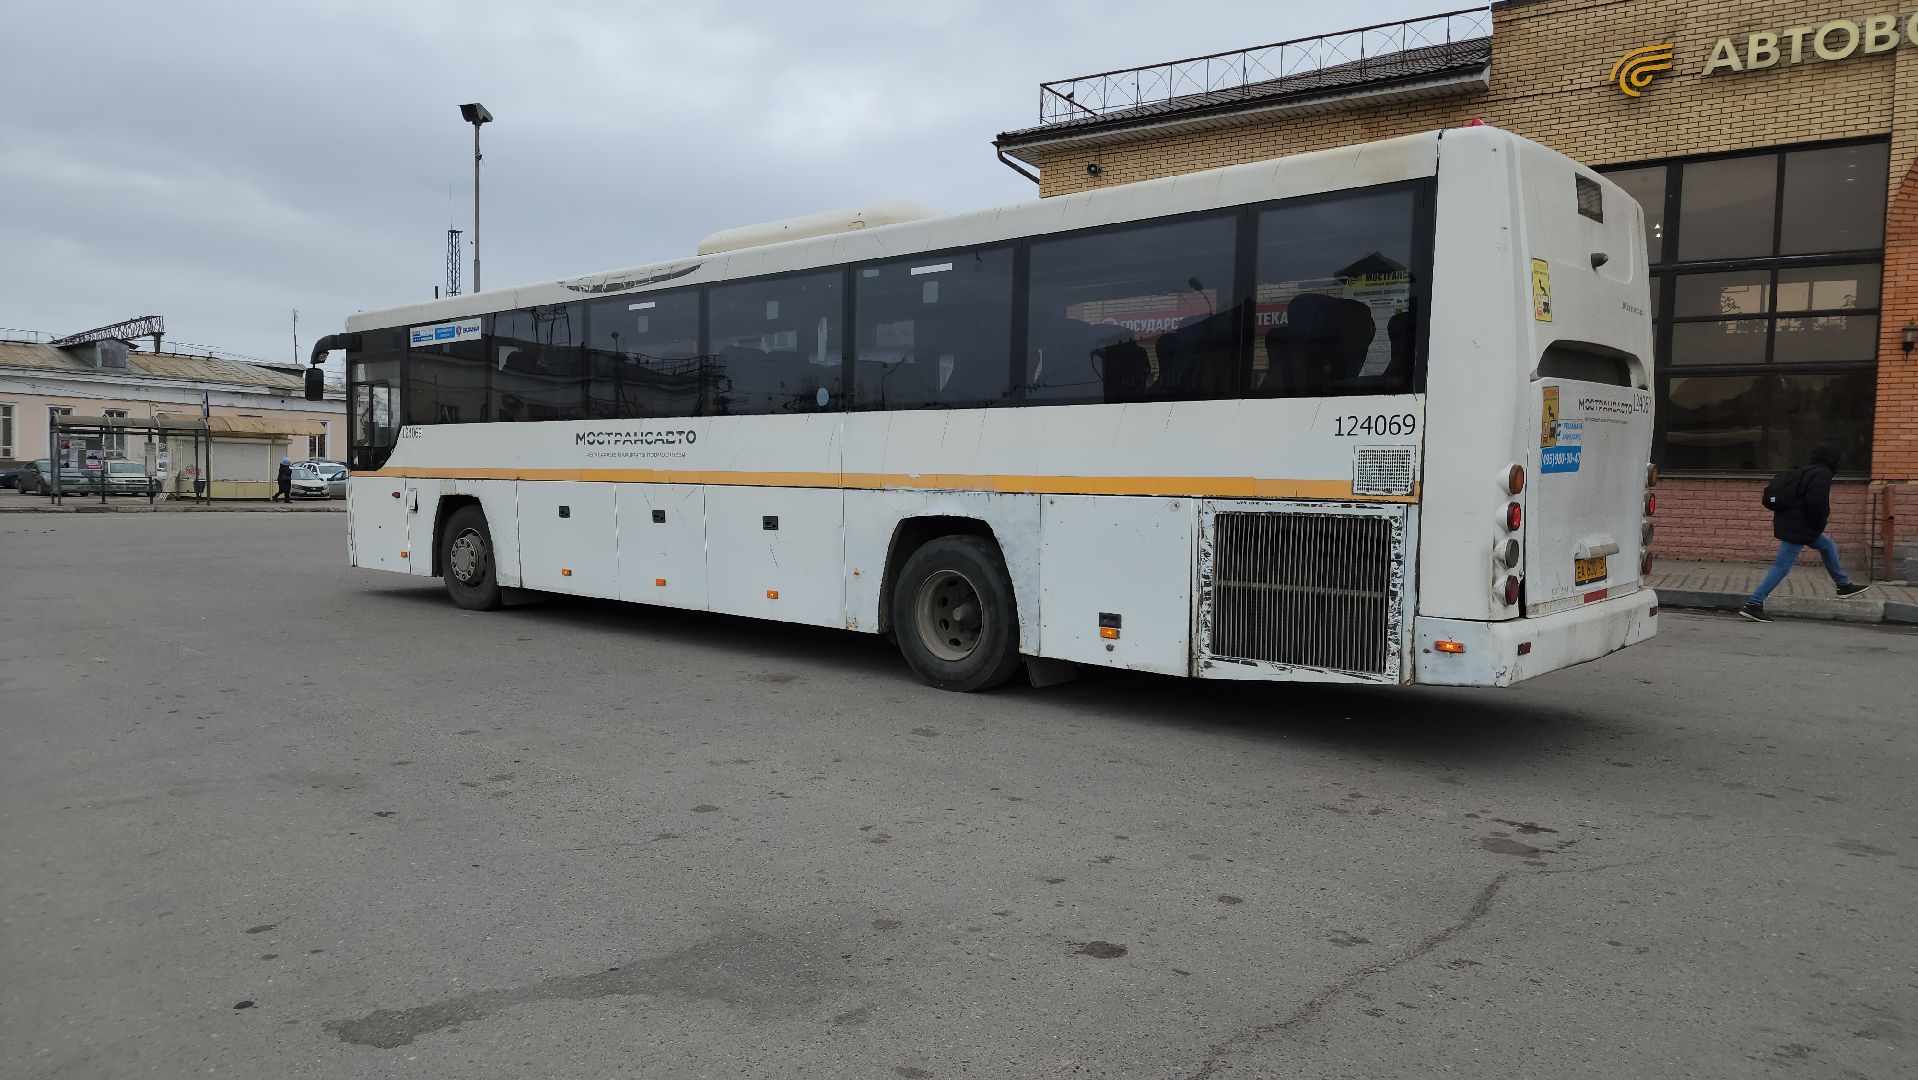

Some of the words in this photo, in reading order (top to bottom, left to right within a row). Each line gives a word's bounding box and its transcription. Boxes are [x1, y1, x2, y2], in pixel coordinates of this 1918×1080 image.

[1701, 11, 1918, 77] АВТОВ
[1256, 311, 1289, 326] ТЕКА
[1334, 413, 1416, 437] 124069
[575, 429, 697, 445] МОСТРАНСАВТО
